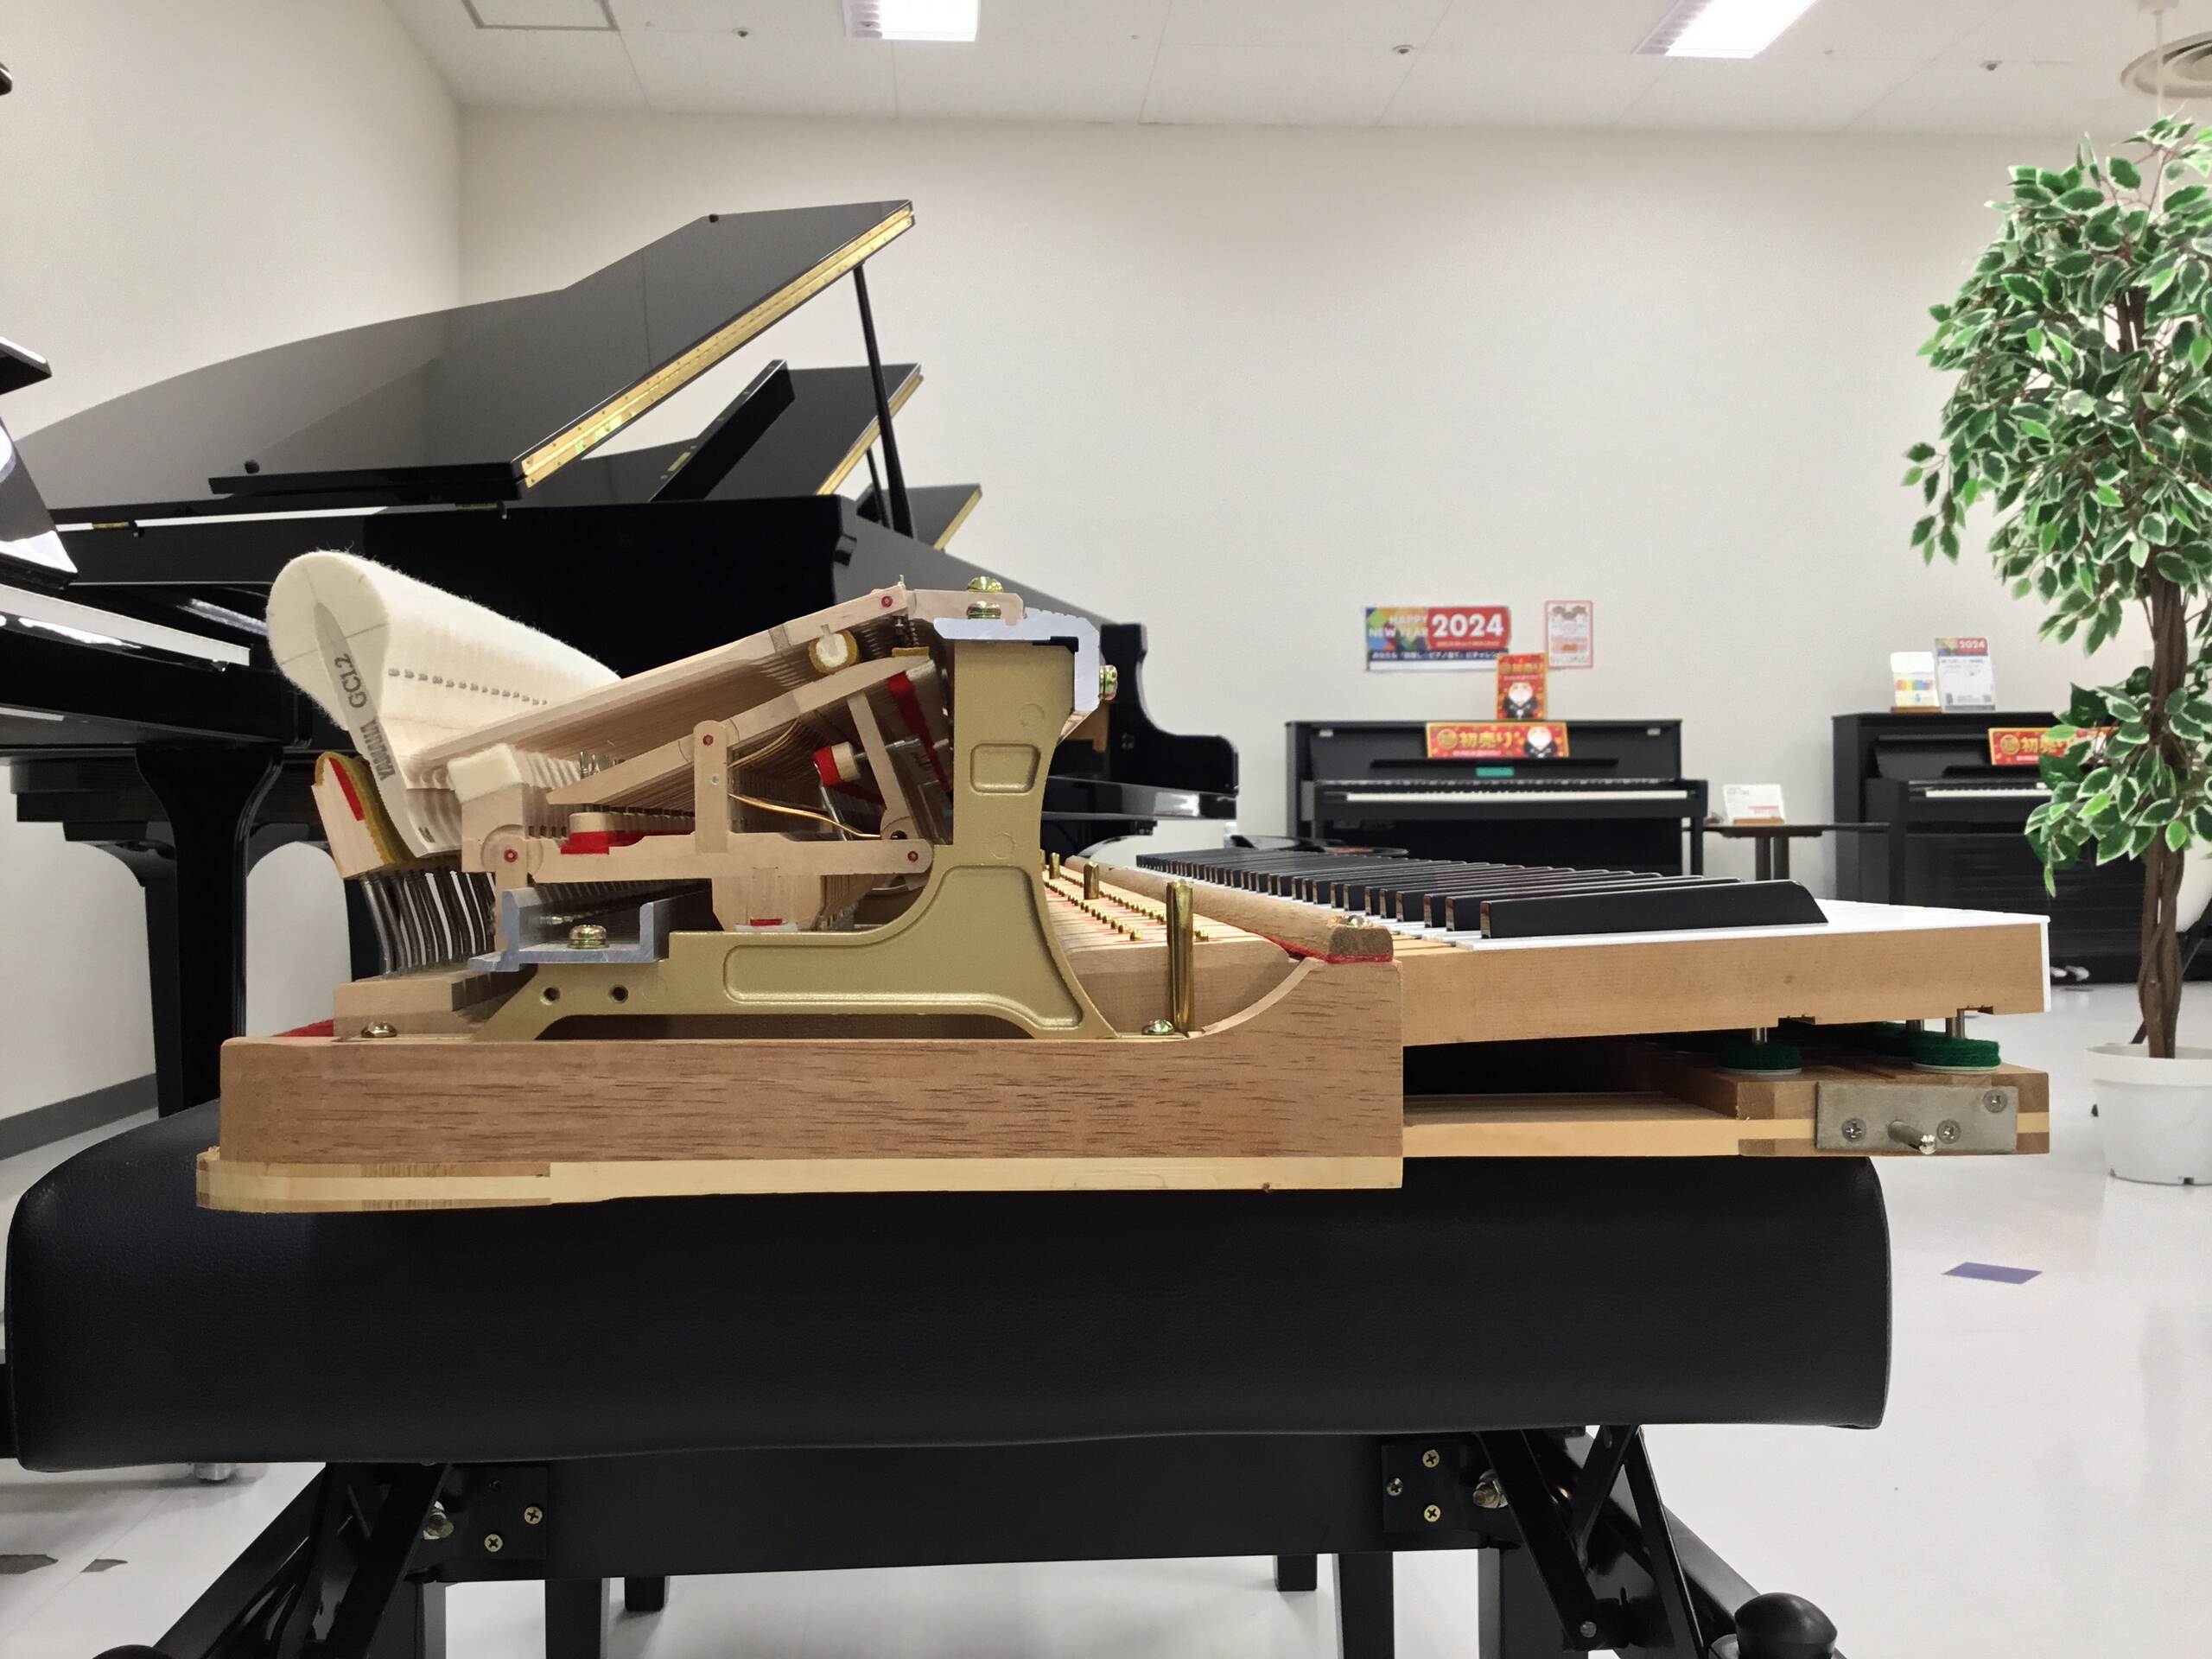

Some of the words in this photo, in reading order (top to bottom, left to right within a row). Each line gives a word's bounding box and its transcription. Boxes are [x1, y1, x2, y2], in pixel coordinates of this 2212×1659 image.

[1389, 614, 1427, 625] HAPPY
[1432, 613, 1504, 638] 2024
[1369, 628, 1396, 637] NEW
[1959, 639, 1986, 649] 2024
[1459, 731, 1513, 748] 初売り
